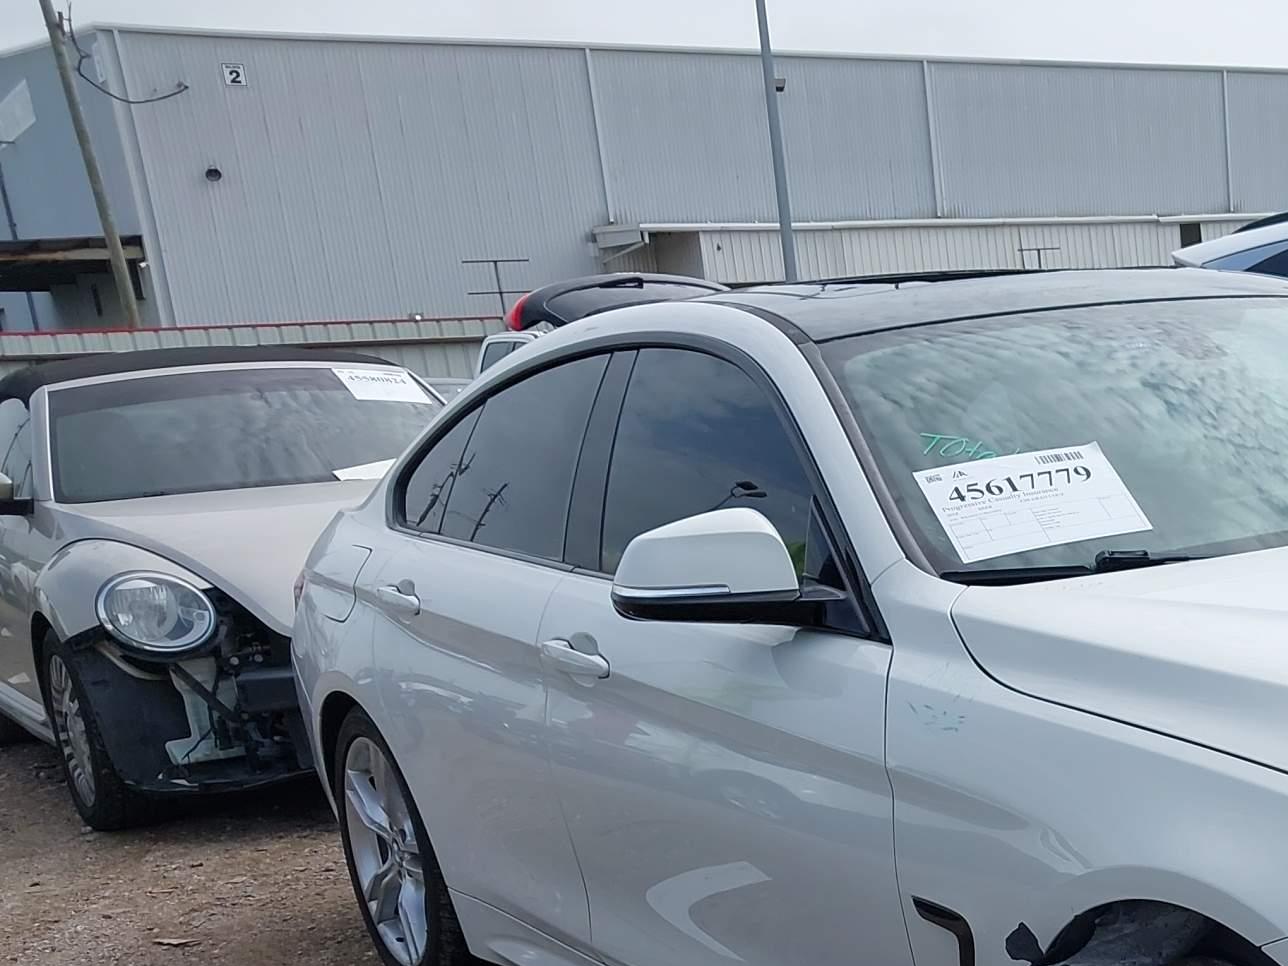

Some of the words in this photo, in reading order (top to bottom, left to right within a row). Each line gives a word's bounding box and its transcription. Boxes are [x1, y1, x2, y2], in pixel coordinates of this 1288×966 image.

[228, 69, 242, 84] 2
[948, 465, 1092, 503] 45617779
[941, 498, 987, 514] Progressive
